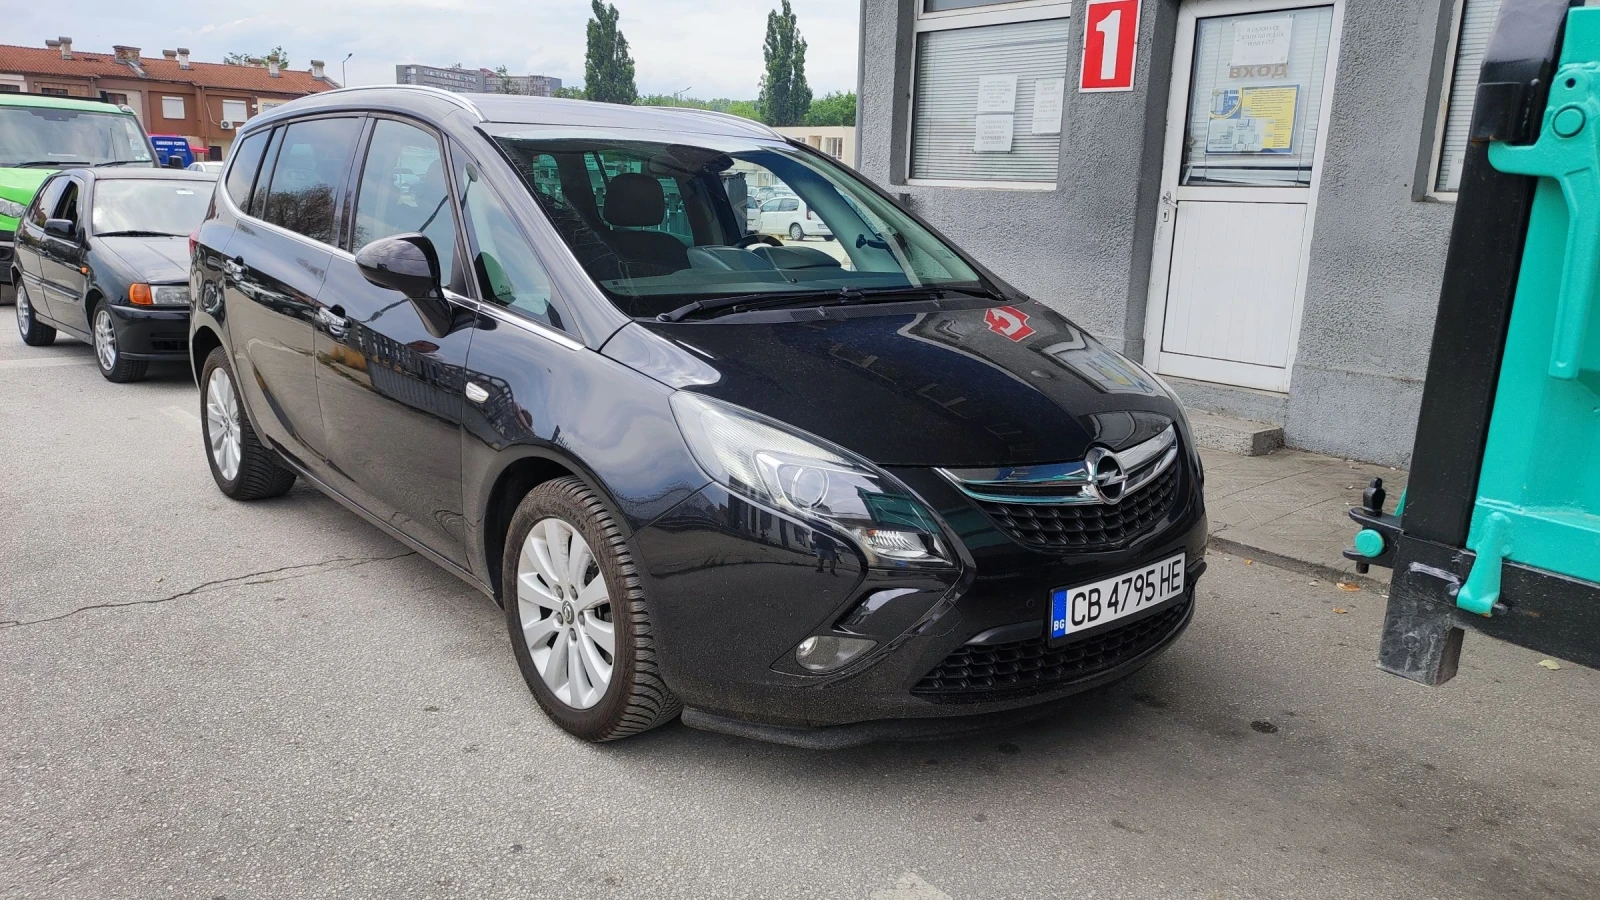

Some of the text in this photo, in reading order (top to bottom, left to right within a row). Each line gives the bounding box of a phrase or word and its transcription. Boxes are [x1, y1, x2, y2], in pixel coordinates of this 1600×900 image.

[1096, 10, 1122, 80] 1
[1229, 64, 1288, 79] ВХОД
[1071, 559, 1182, 626] CB 4795 HE
[1053, 619, 1065, 631] BG
